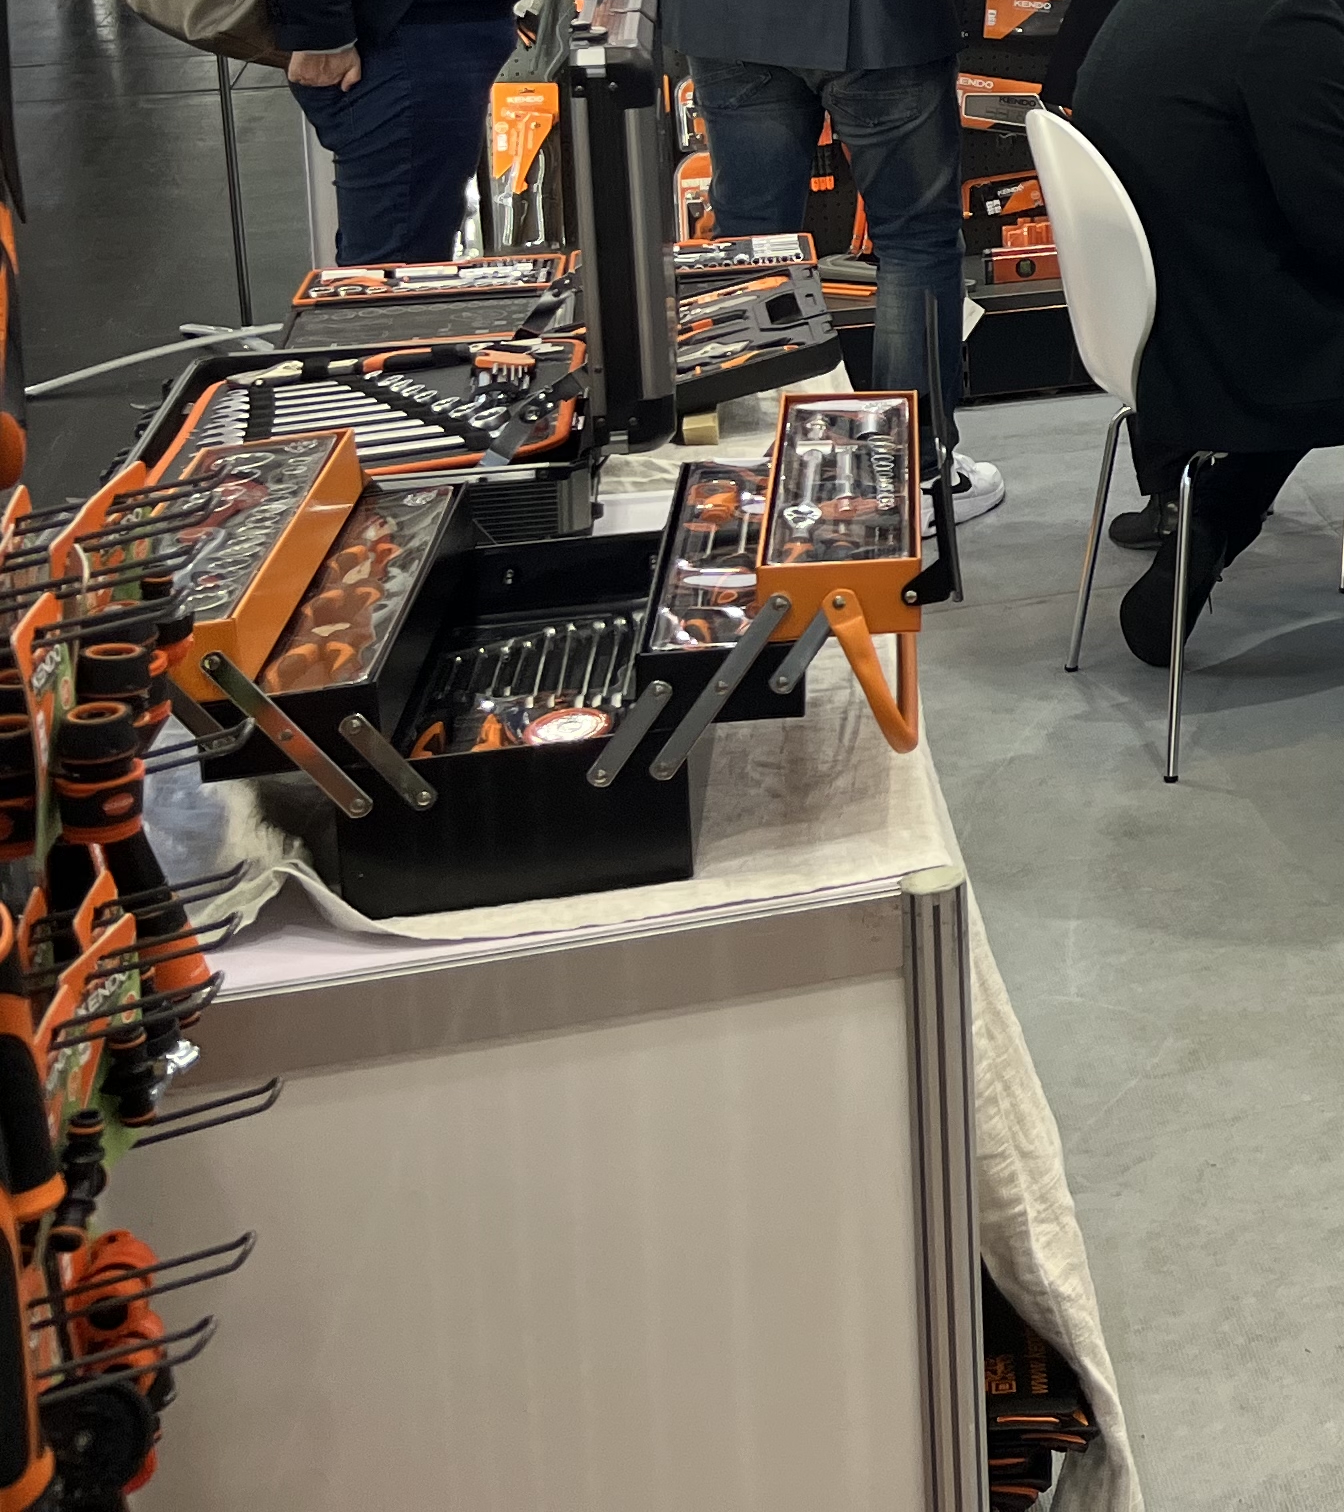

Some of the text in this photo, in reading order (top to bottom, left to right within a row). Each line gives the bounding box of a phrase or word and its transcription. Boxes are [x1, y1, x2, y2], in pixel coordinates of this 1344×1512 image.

[1013, 0, 1052, 10] KENDO
[506, 94, 545, 104] KENDO
[998, 96, 1037, 107] KENDO
